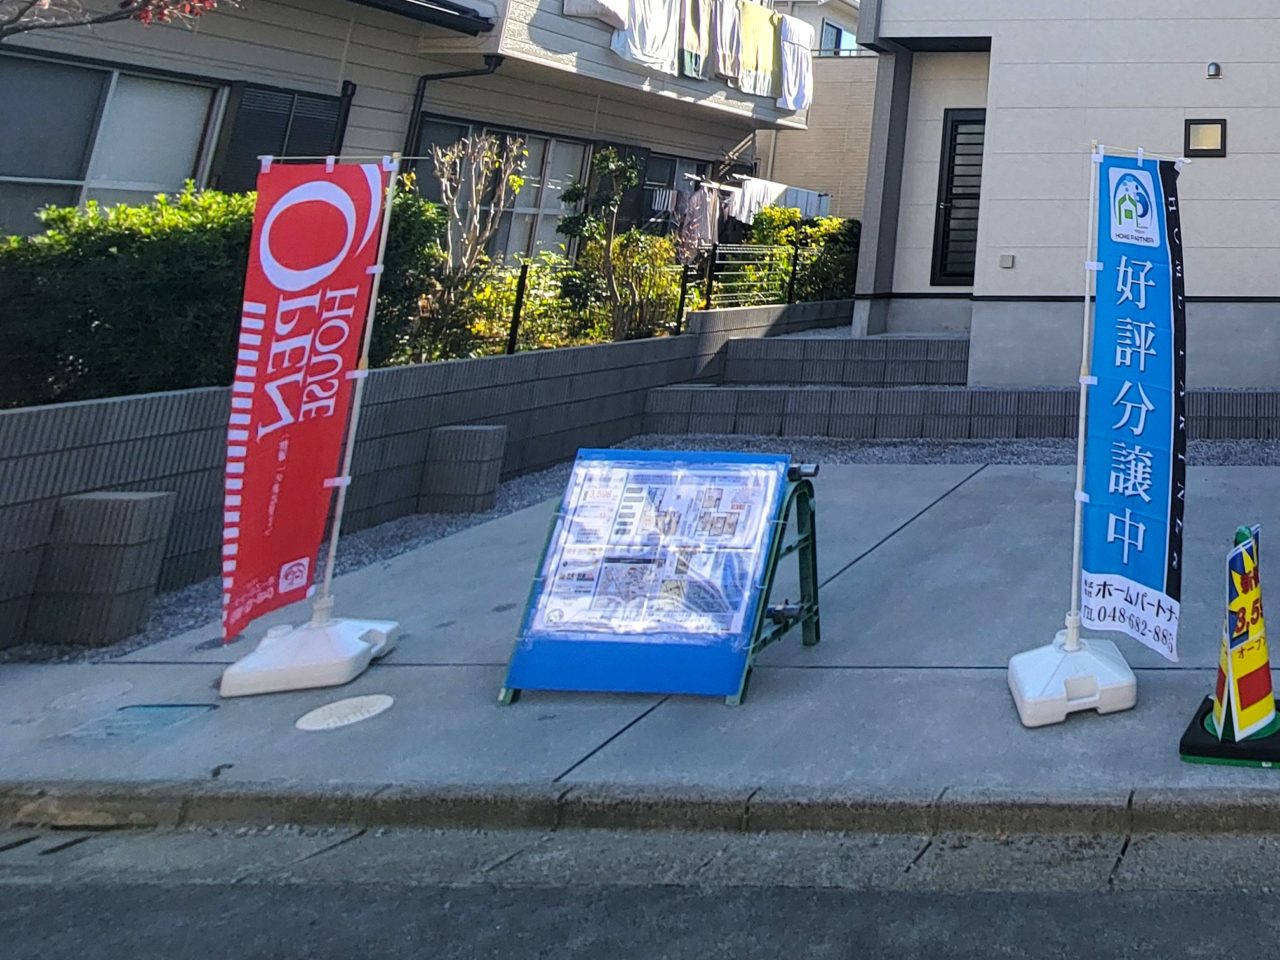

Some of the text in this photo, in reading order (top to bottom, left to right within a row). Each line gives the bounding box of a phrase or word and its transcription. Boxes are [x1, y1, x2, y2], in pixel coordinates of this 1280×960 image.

[1106, 254, 1158, 566] 好評分譲中
[1234, 598, 1264, 634] 3,5
